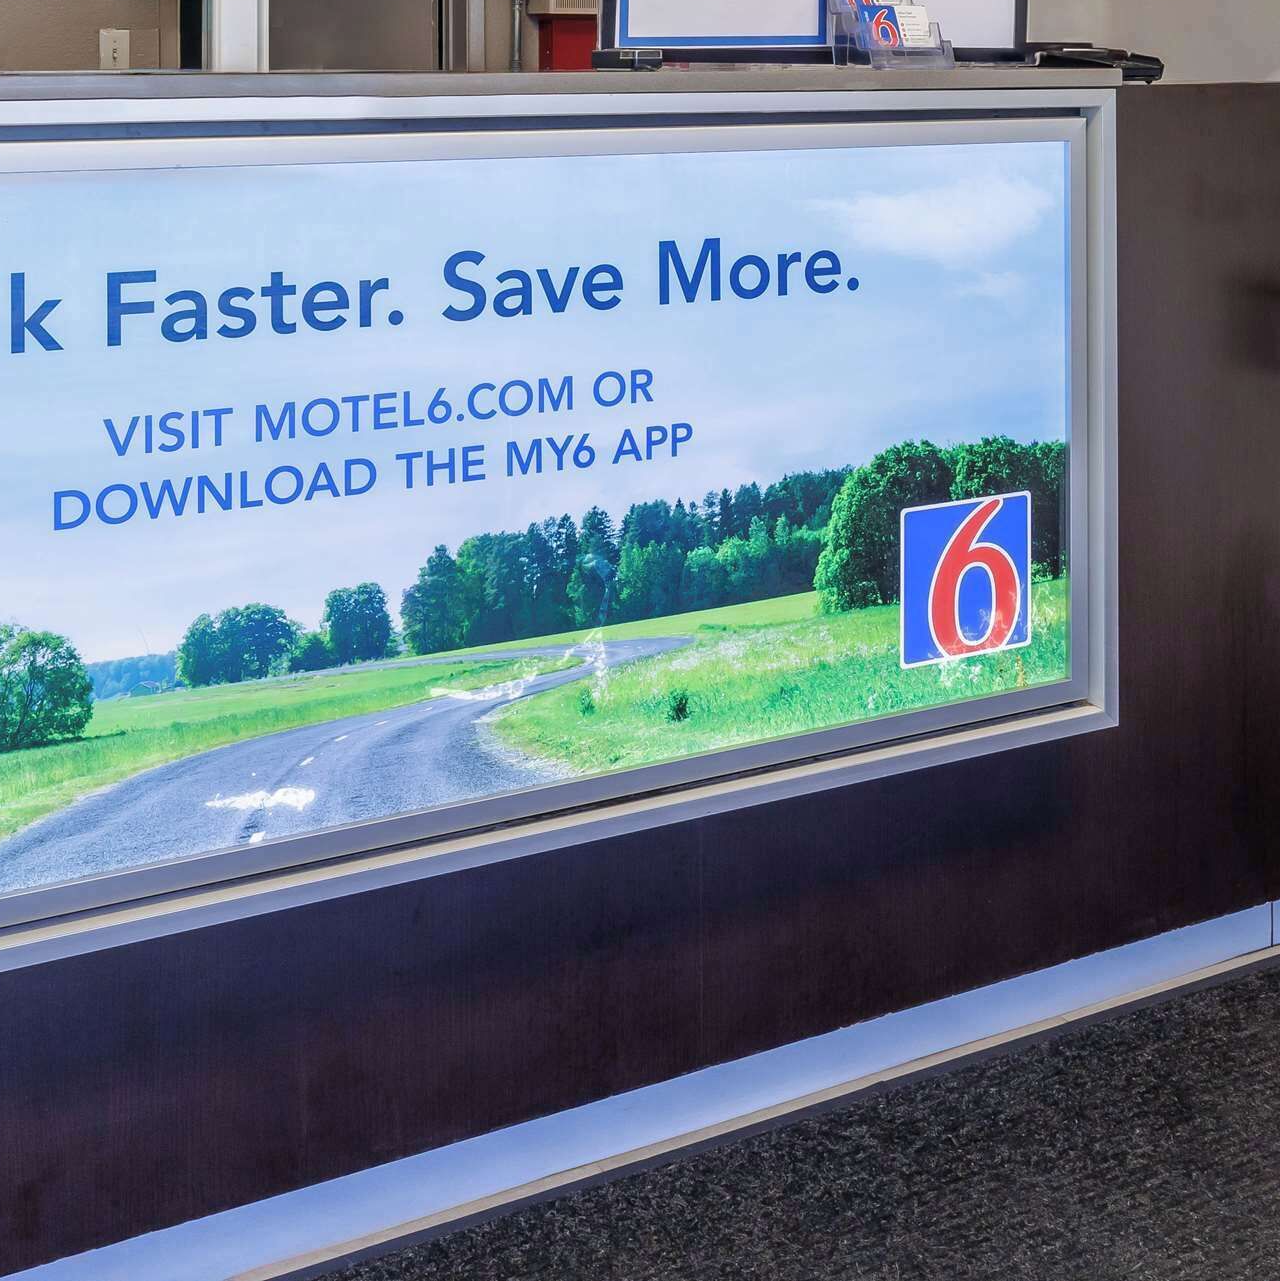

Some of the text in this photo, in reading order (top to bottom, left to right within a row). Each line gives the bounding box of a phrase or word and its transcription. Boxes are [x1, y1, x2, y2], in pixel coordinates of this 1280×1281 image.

[872, 9, 900, 48] 6
[107, 269, 403, 347] Faster.
[441, 250, 622, 322] Save
[656, 237, 861, 306] More.
[103, 368, 654, 457] VISIT MOTEL6.COM OR
[53, 422, 693, 531] DOWNLOAD THE MY6 APP
[928, 497, 1020, 659] 6
